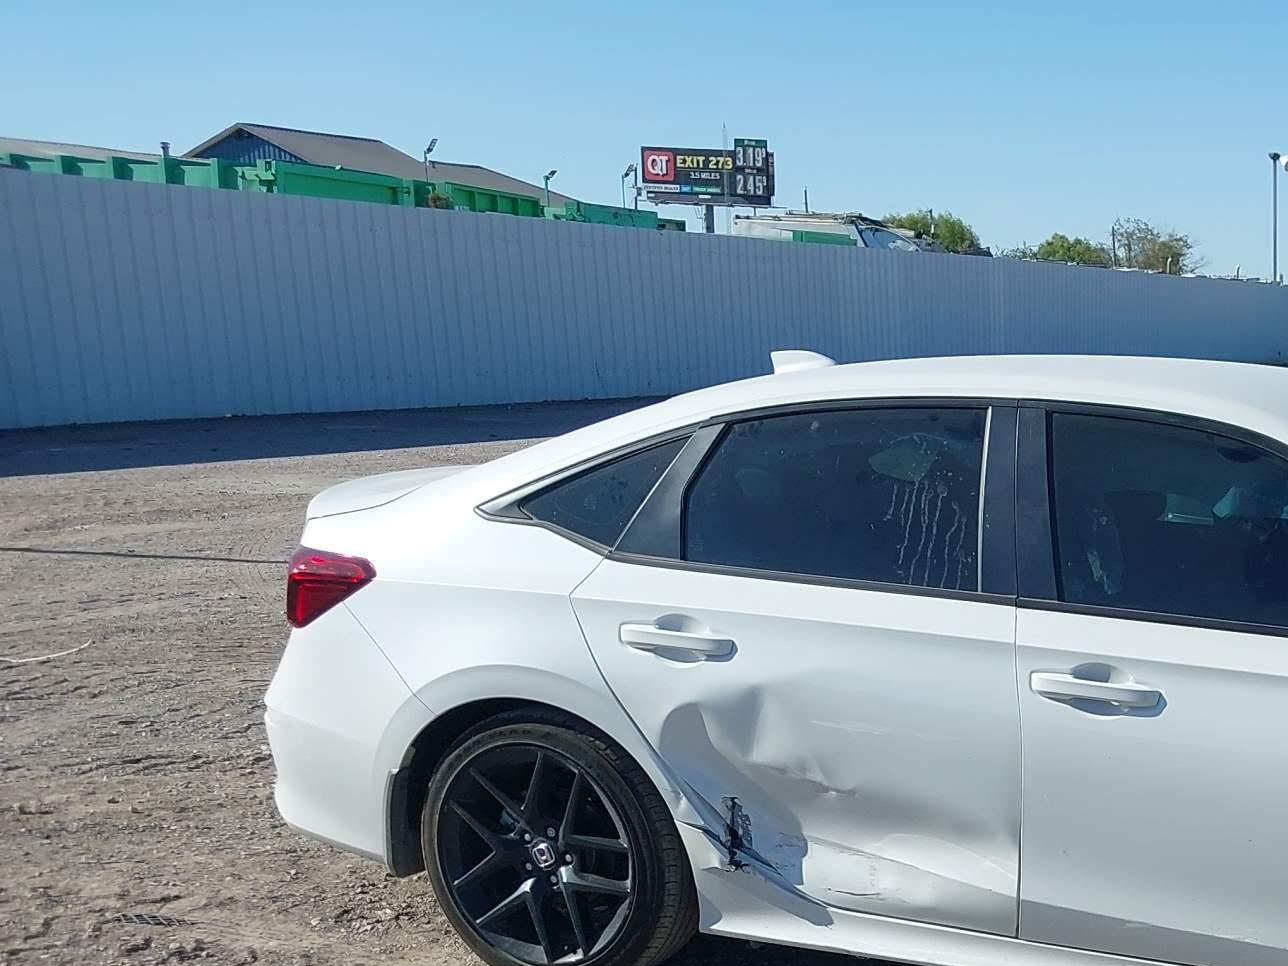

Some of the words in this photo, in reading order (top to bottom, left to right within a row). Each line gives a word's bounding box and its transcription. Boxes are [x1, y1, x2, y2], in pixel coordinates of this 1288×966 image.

[647, 154, 669, 176] QT
[676, 155, 706, 168] EXIT
[708, 156, 733, 169] 273
[700, 172, 721, 180] MILES
